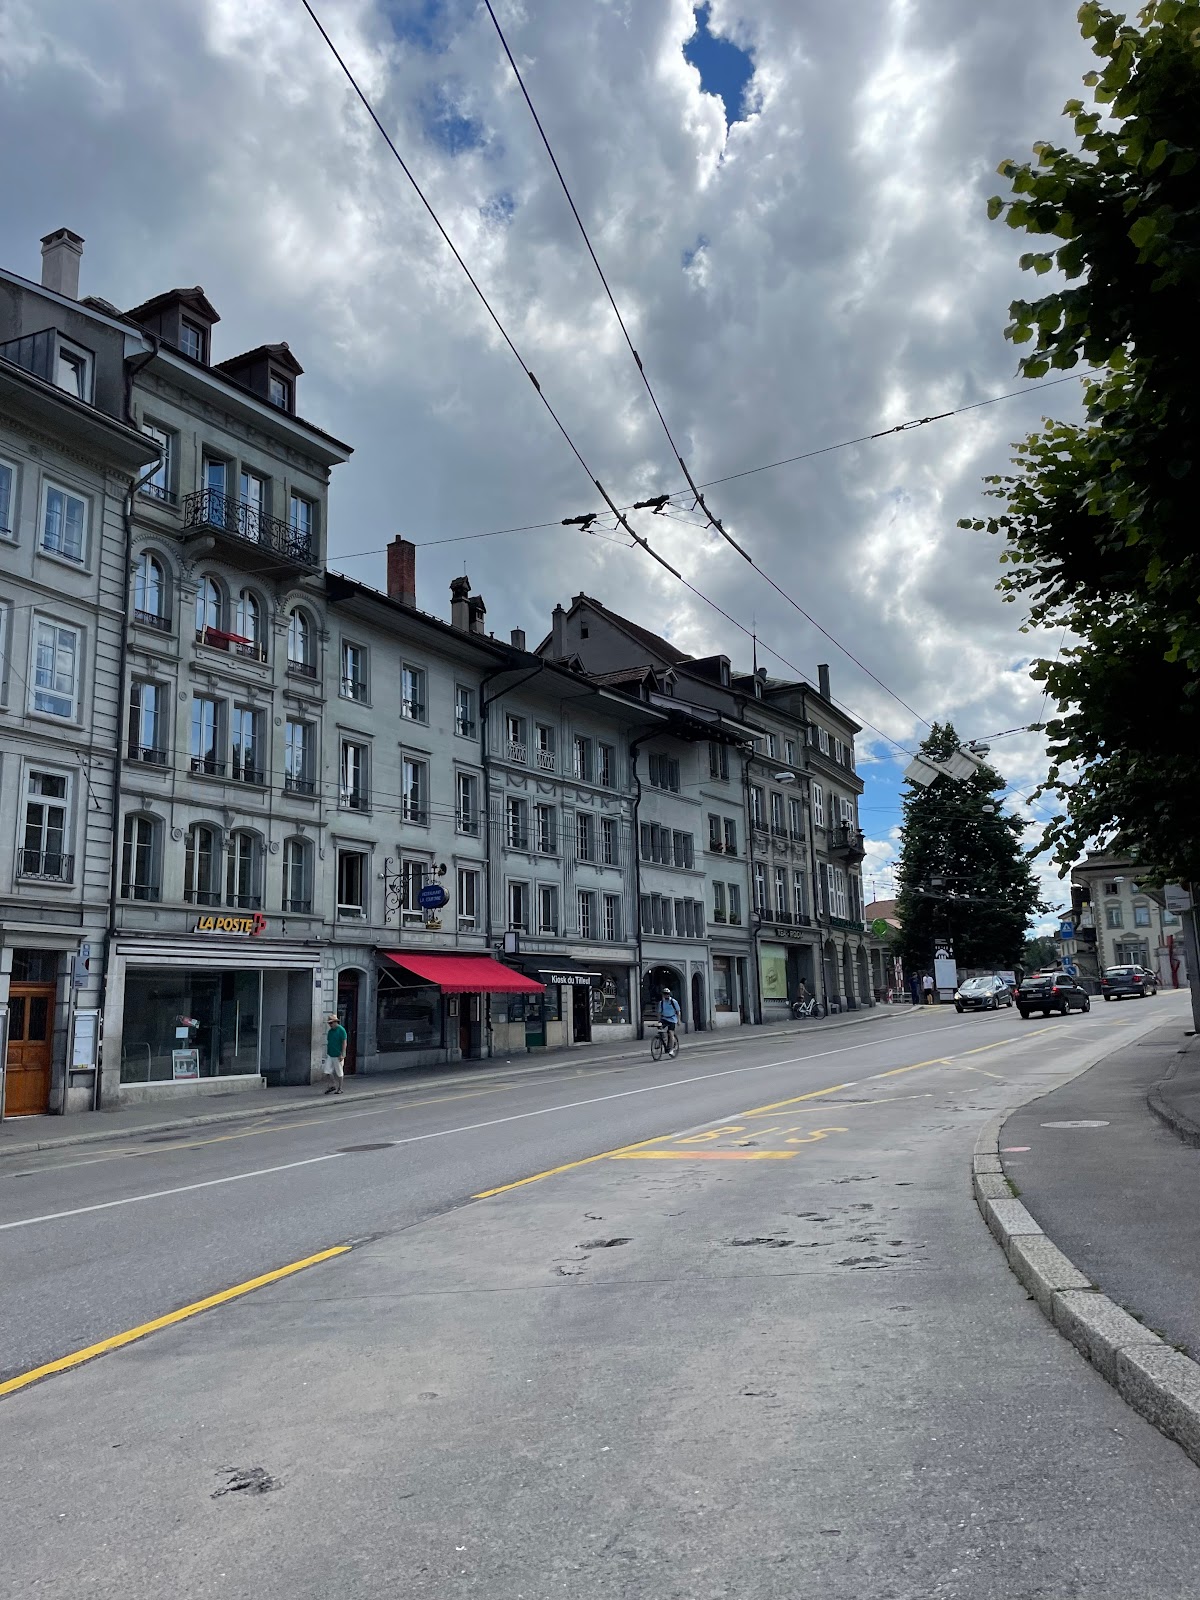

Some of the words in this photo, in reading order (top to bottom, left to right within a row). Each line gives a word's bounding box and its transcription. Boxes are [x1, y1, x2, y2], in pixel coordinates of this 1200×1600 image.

[199, 916, 214, 930] LA
[215, 917, 254, 932] POSTE
[551, 975, 567, 984] Kiosk
[567, 976, 575, 984] du
[575, 976, 591, 985] Tilleul
[672, 1126, 849, 1145] BUS
